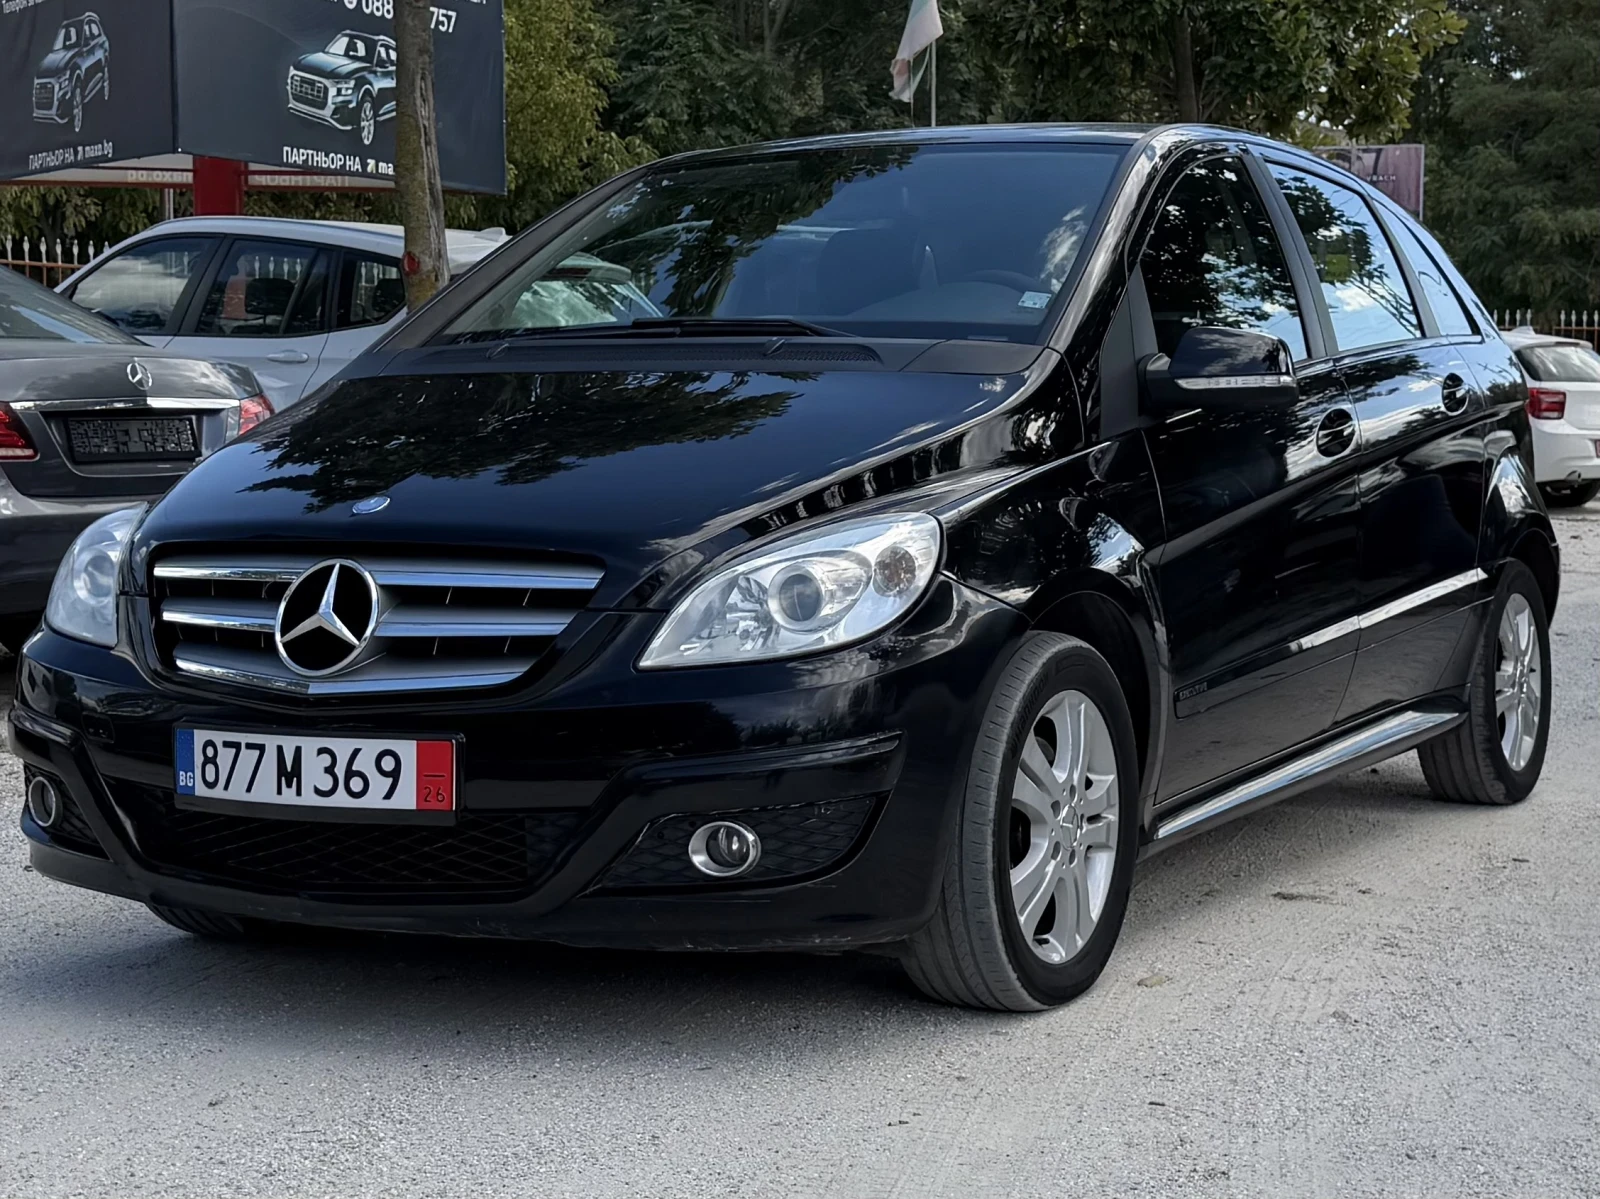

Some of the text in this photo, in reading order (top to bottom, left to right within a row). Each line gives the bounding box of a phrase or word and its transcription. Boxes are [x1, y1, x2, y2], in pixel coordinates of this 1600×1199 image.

[429, 6, 457, 33] 757
[29, 149, 65, 170] ПАРТНЬОР
[65, 147, 75, 164] НА
[283, 146, 345, 169] ПАРТНЬОР
[346, 156, 362, 172] НА
[178, 770, 194, 787] BG
[201, 738, 402, 801] 877 M 369
[423, 786, 446, 803] 26
